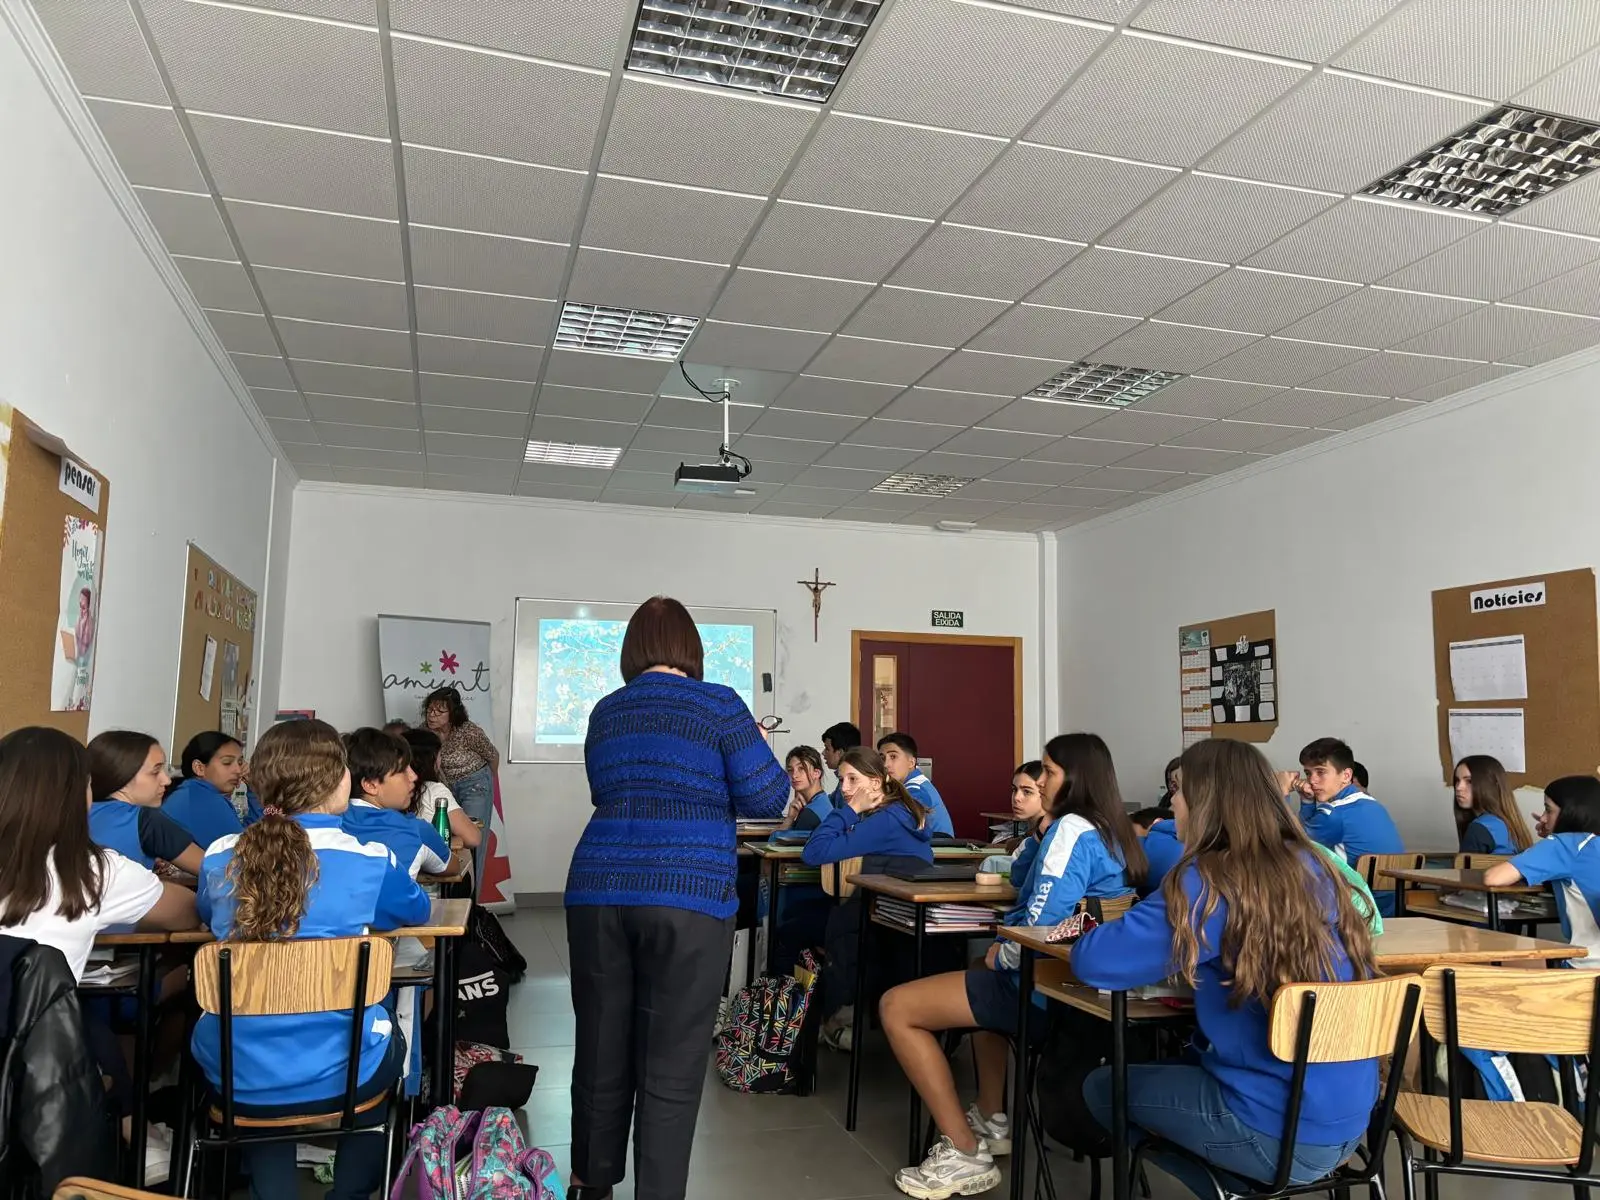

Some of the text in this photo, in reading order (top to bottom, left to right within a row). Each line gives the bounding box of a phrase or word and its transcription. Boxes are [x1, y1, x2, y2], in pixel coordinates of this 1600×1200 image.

[64, 462, 96, 496] pensar
[933, 611, 962, 620] SALIDA
[935, 619, 960, 627] EIXIDA
[383, 661, 490, 692] amunt
[1027, 881, 1053, 926] oma
[458, 970, 500, 1001] ANS
